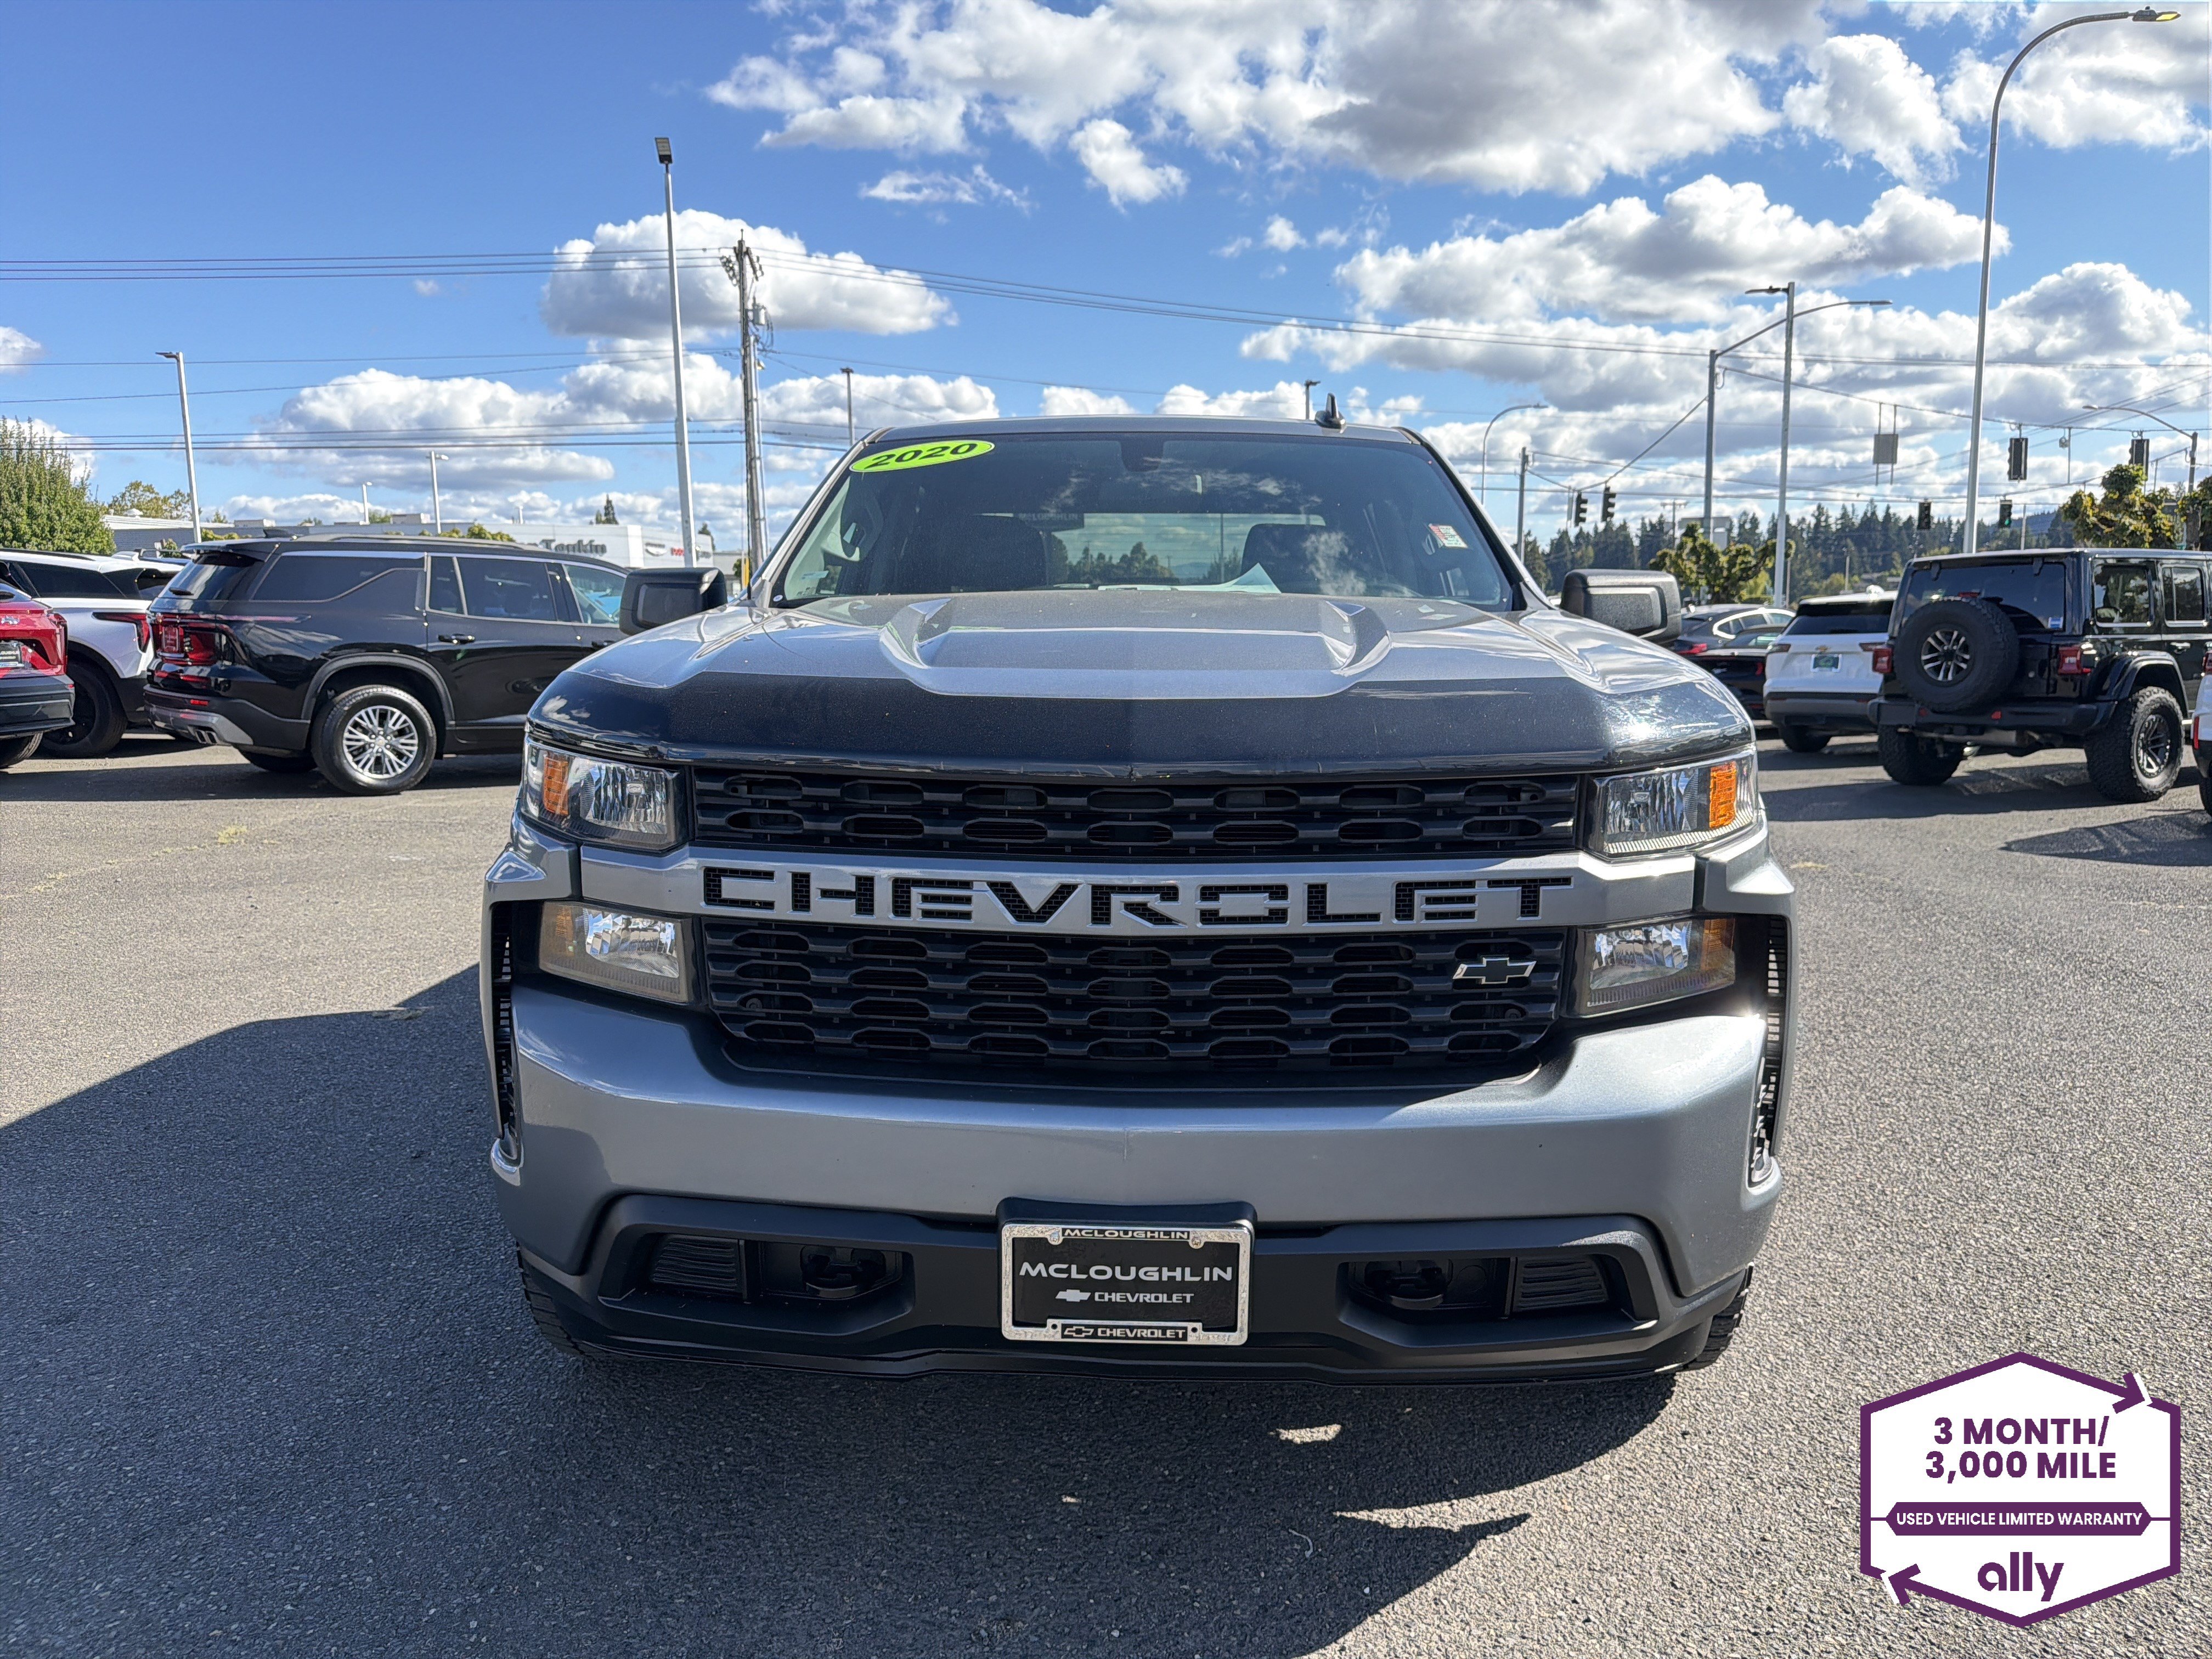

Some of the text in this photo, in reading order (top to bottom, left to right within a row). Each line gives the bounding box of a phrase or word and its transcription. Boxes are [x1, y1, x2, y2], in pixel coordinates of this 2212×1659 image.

[864, 443, 978, 470] 2020
[703, 867, 1573, 926] CHEVROLET
[1064, 1229, 1189, 1239] MCLOUGHLIN
[1019, 1262, 1233, 1282] MCLOUGHLIN
[1094, 1291, 1194, 1304] CHEVROLET
[1097, 1328, 1186, 1339] CHEVROLET
